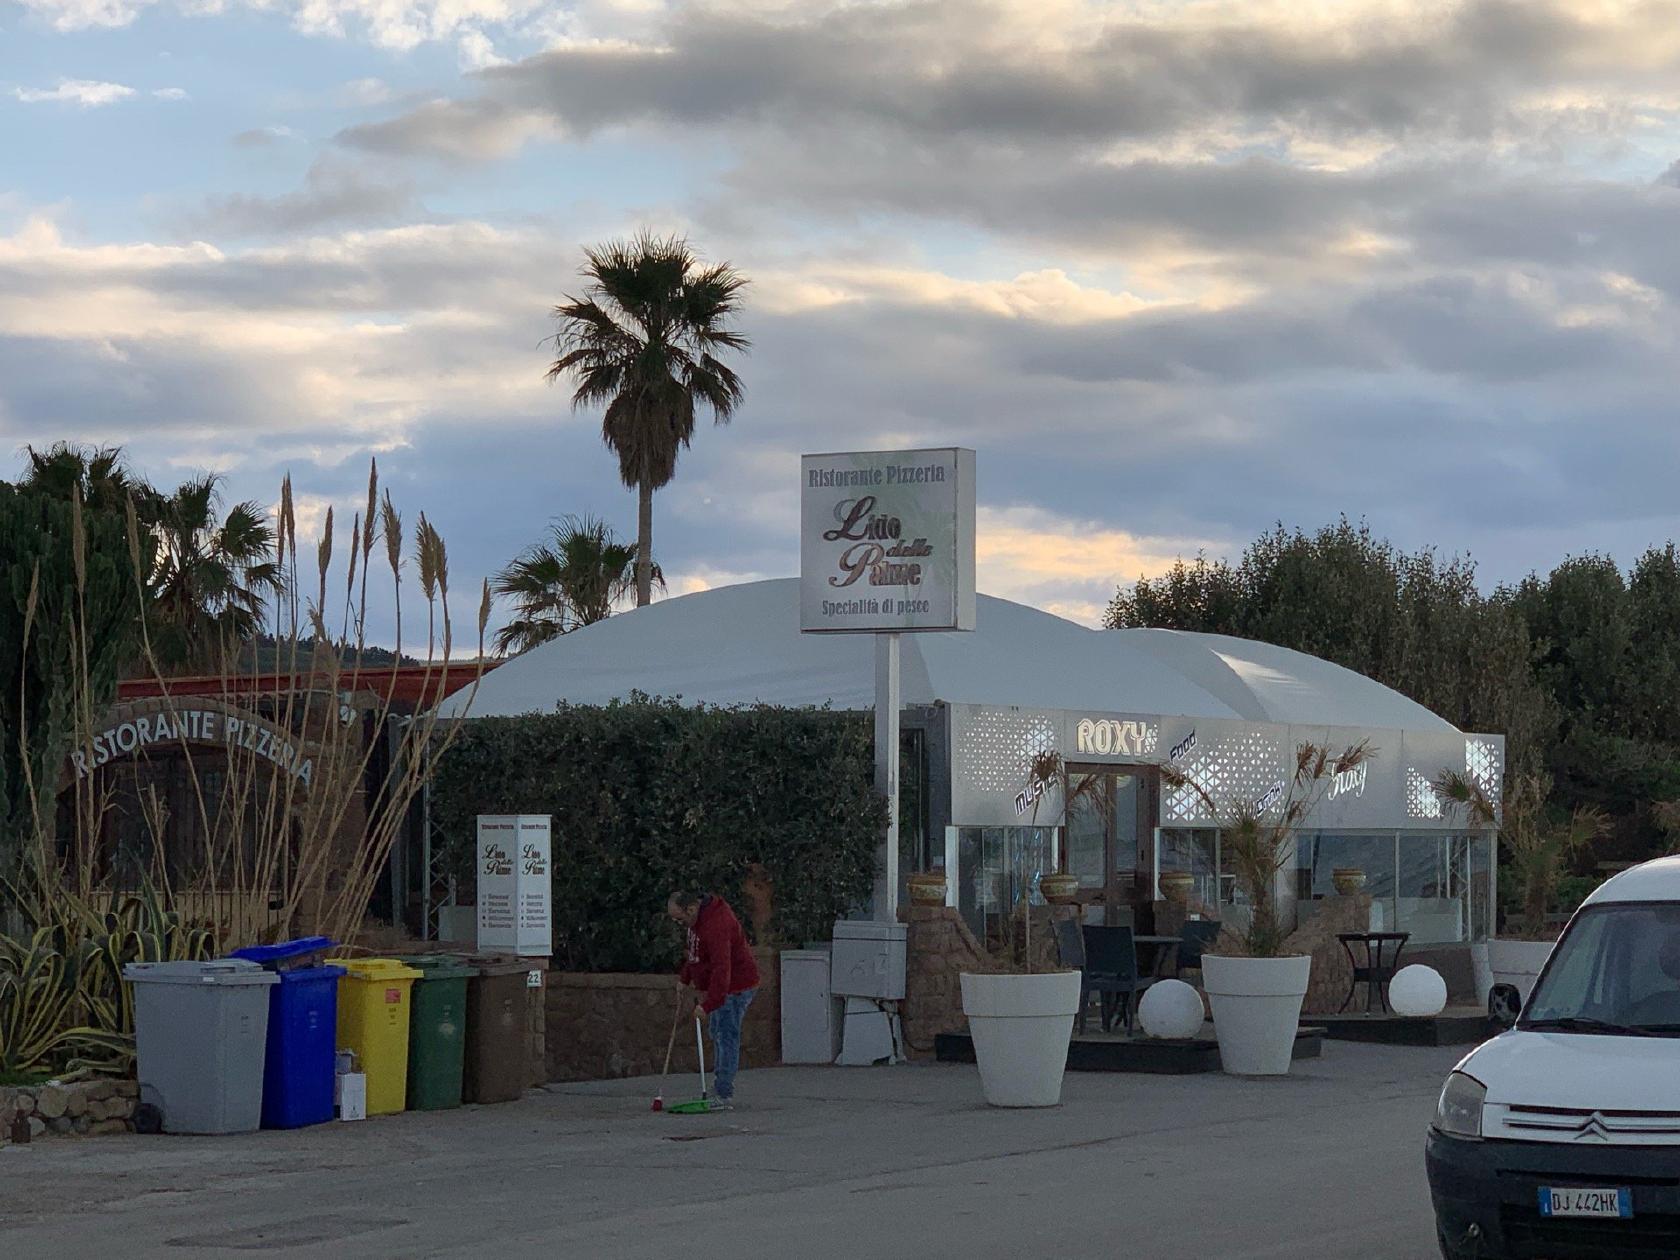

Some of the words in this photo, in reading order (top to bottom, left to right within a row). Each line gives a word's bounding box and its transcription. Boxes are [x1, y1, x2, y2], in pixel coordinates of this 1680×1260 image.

[808, 466, 883, 488] Ristorante
[886, 464, 945, 485] Pizzeria
[822, 495, 902, 542] Lido
[885, 538, 934, 558] delle
[828, 542, 922, 588] Palme
[822, 600, 879, 617] Specialità
[882, 598, 894, 614] di
[897, 600, 929, 616] pesce
[1076, 718, 1147, 756] ROXY
[528, 973, 539, 984] 22
